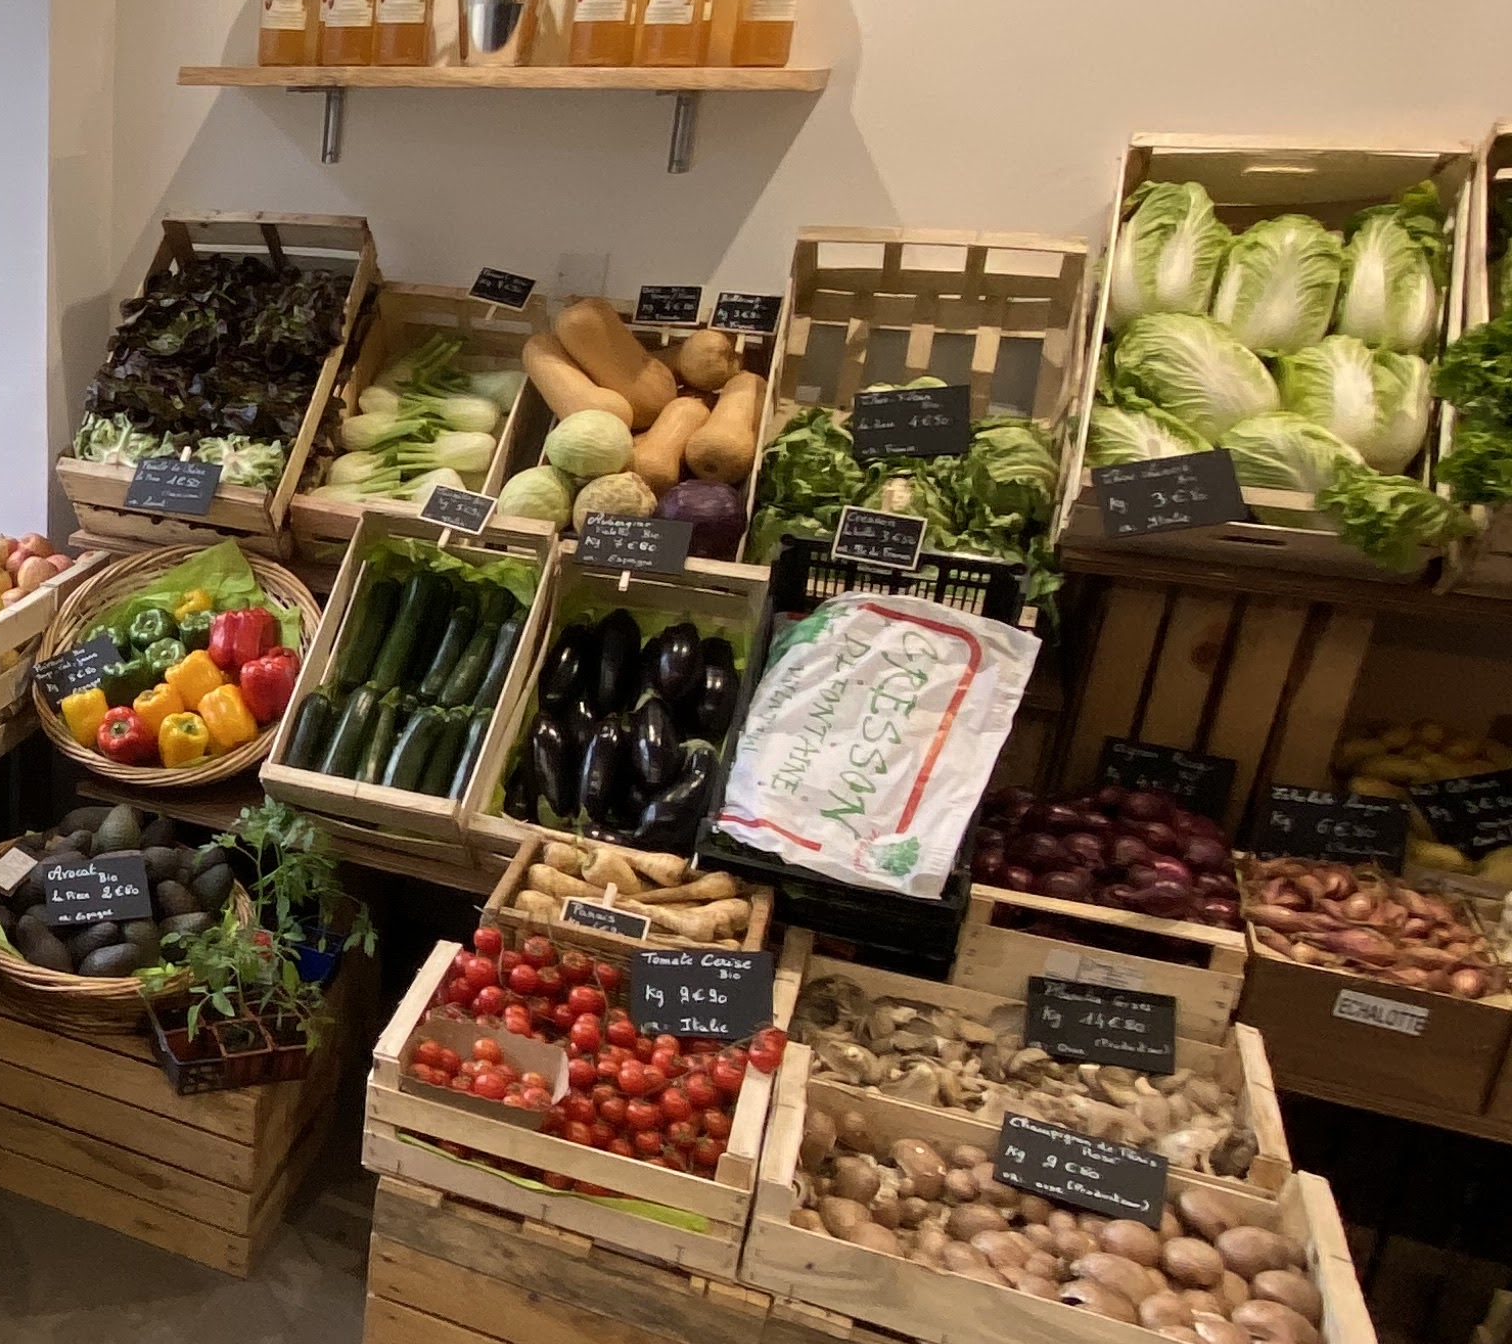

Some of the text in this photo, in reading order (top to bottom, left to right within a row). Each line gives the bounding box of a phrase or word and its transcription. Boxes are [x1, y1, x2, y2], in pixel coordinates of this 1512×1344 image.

[771, 678, 848, 795] FONTAINE
[819, 630, 937, 840] CRESSON
[47, 863, 97, 881] Avocat
[98, 872, 118, 883] Bio
[641, 952, 752, 969] Tomate Cerise
[719, 969, 741, 980] Bio
[645, 984, 664, 1008] Kg
[680, 1017, 728, 1033] Italie
[1005, 1145, 1026, 1164] Kg
